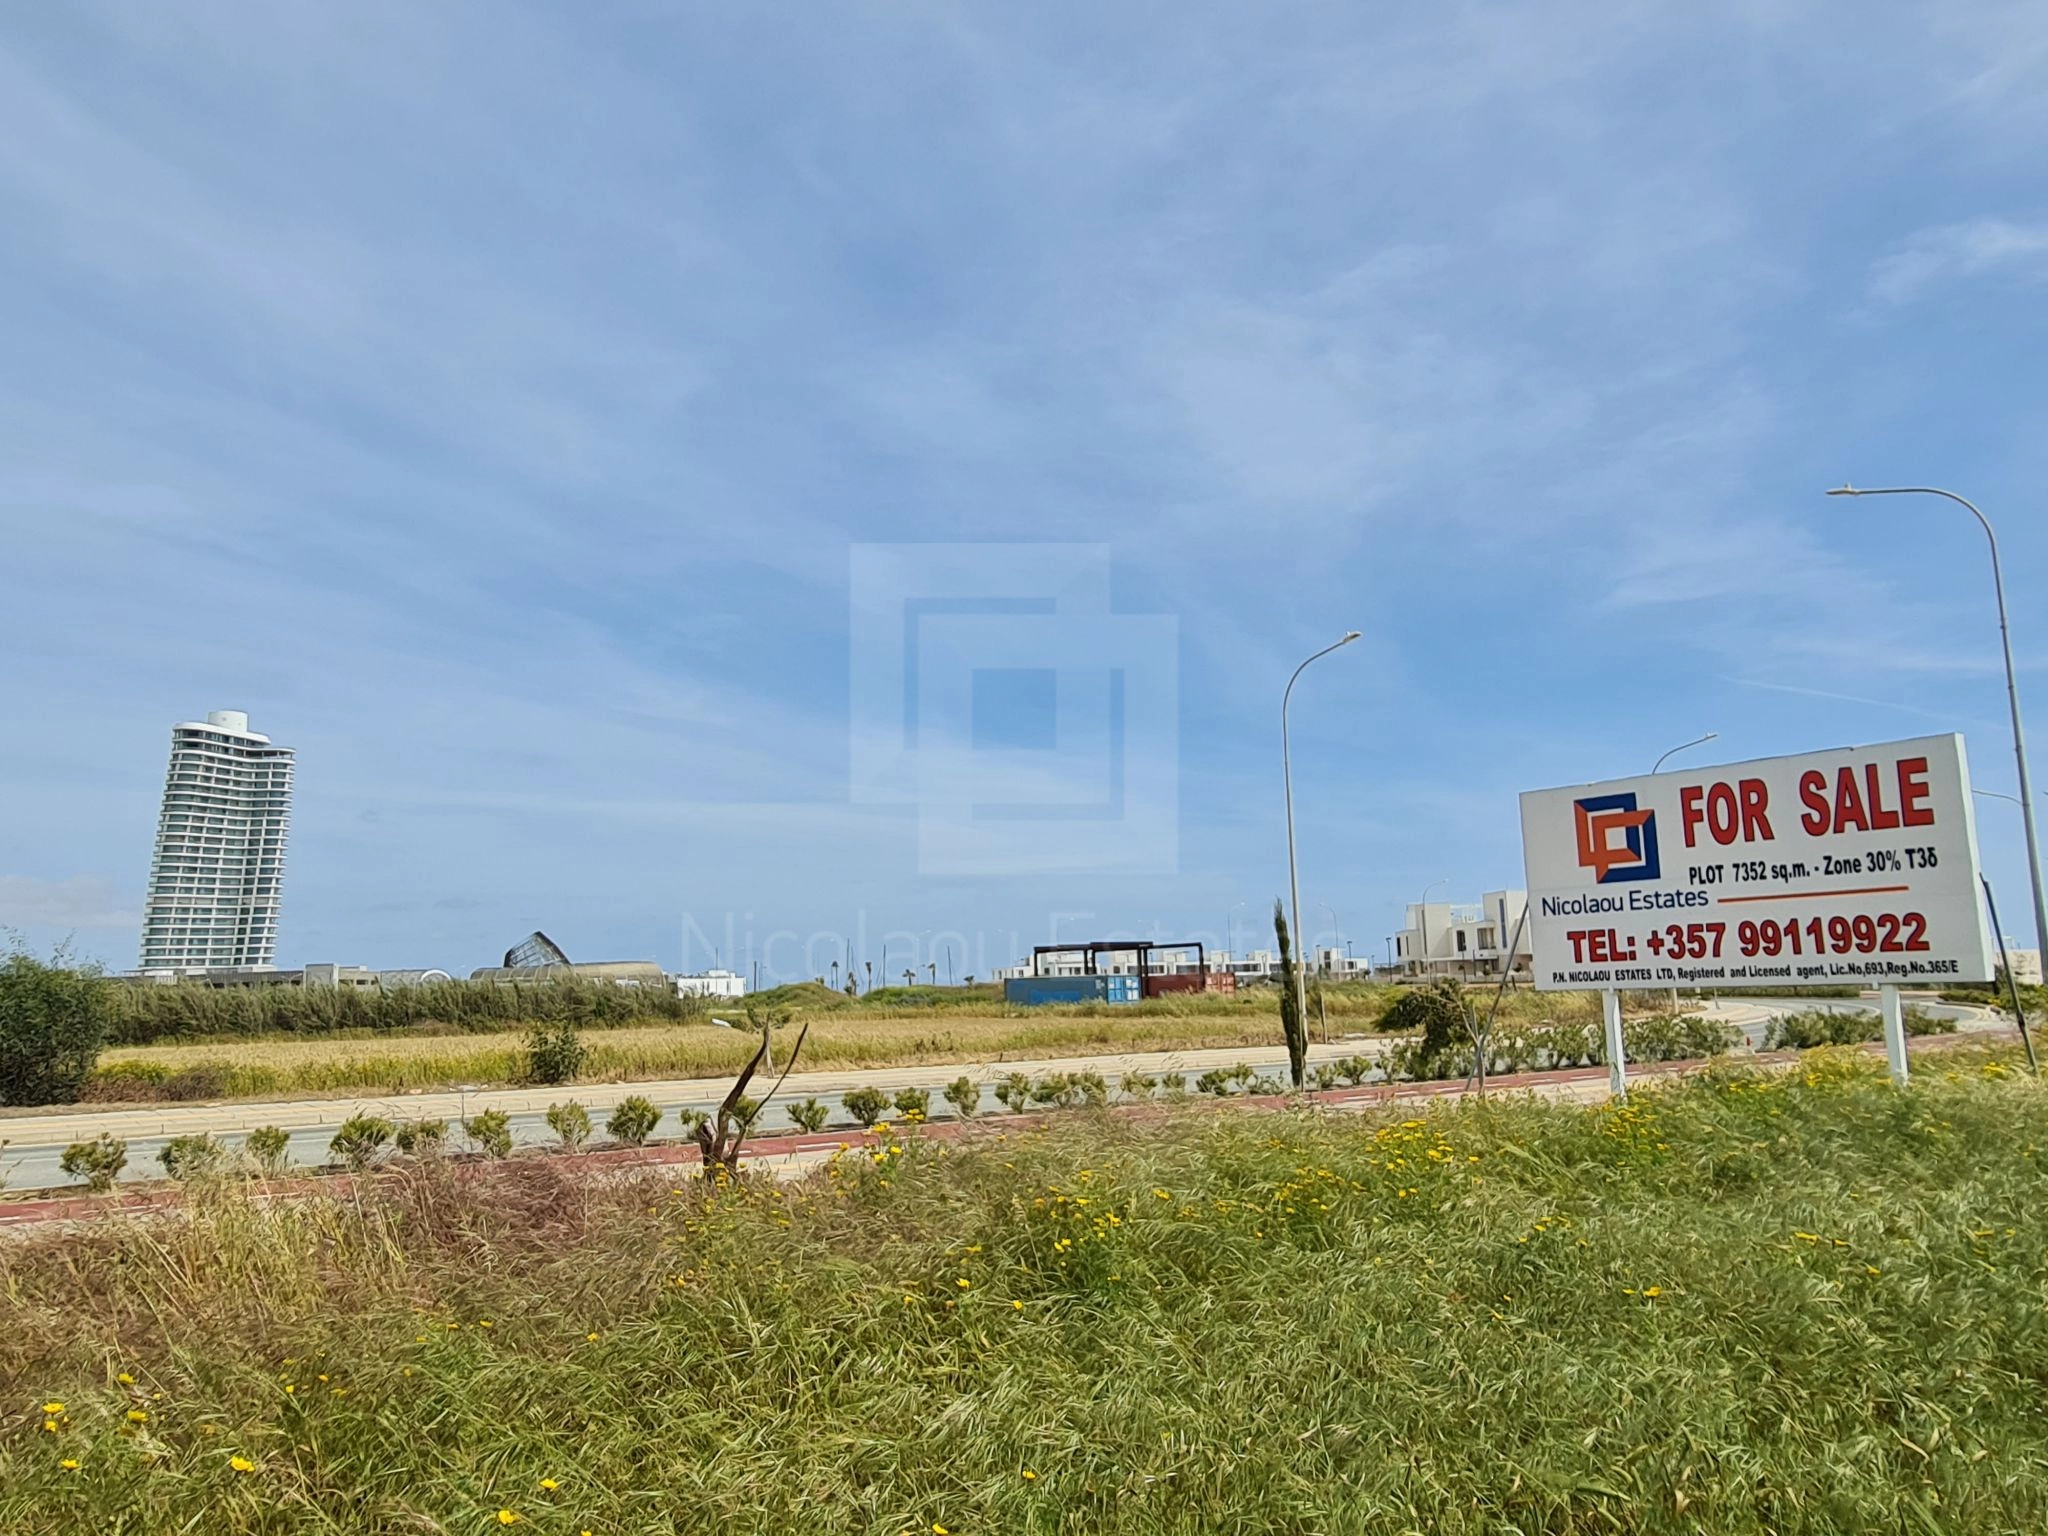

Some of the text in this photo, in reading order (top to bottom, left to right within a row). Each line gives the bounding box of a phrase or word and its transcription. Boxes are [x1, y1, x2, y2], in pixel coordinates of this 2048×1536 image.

[1680, 756, 1935, 848] FOR SALE
[1689, 864, 1724, 885] PLOT
[1732, 861, 1767, 882] 7352
[1771, 860, 1810, 883] sq.m.
[1823, 855, 1862, 876] Zone
[1866, 849, 1901, 873] 30%
[1542, 889, 1709, 917] Nicolaou Estates
[1567, 912, 1930, 963] TEL: +357 99119922
[1553, 971, 1567, 983] P.N.
[1569, 970, 1610, 982] NICOLAOU
[1615, 968, 1652, 981] ESTATES
[1656, 967, 1676, 981] LTD,
[1678, 965, 1725, 981] Registered
[1730, 965, 1747, 978] and
[1749, 963, 1791, 978] Licensed
[1797, 964, 1828, 979] agent,
